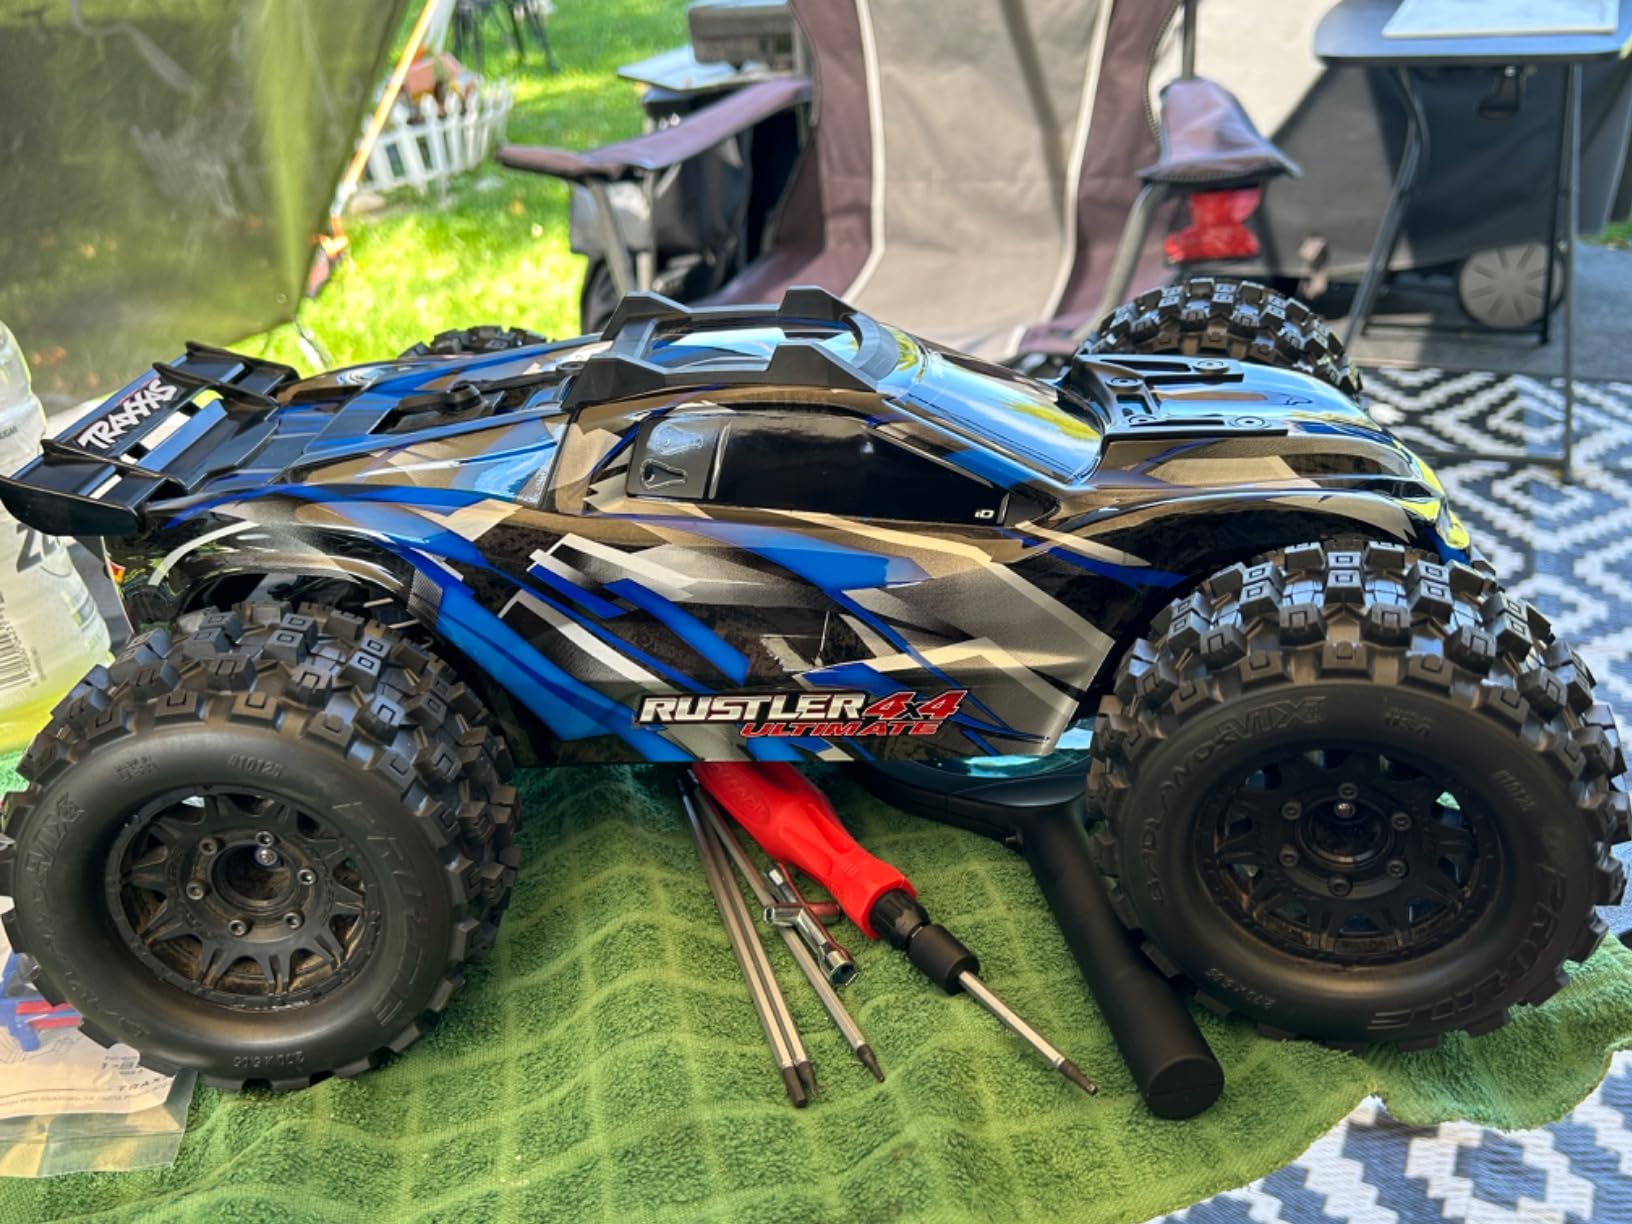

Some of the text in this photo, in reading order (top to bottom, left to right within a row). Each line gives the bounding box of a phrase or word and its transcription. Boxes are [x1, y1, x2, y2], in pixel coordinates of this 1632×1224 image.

[77, 377, 178, 449] TRAXXAS
[638, 693, 867, 722] RUSTLER
[740, 720, 944, 736] ULTIMATE
